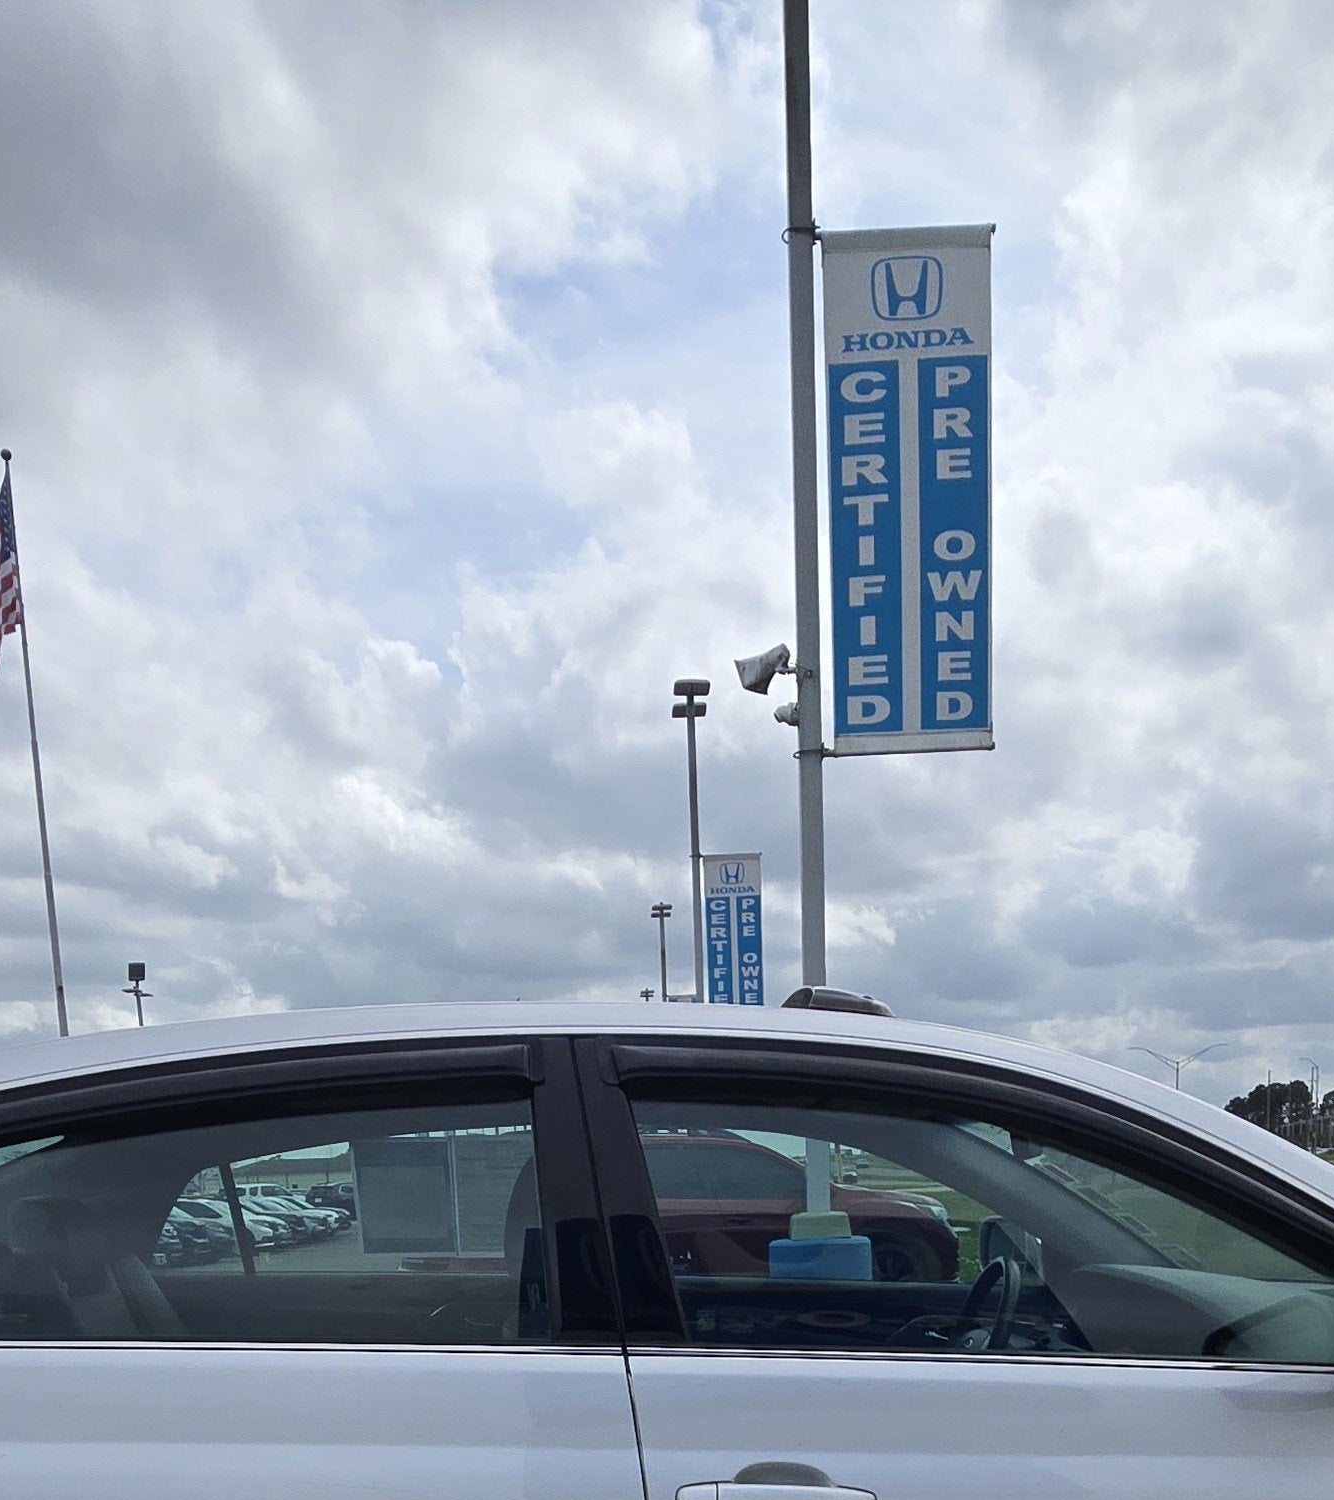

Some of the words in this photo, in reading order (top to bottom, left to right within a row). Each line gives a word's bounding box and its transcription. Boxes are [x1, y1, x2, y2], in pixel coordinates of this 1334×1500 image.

[841, 327, 975, 353] HONDA
[932, 366, 972, 480] PRE
[840, 370, 892, 726] CERTIFIED
[927, 528, 983, 722] OWNED
[710, 885, 756, 895] HONDA
[741, 898, 756, 937] PRE
[709, 899, 729, 1003] CERTIFIE
[741, 952, 760, 1004] OWNE
